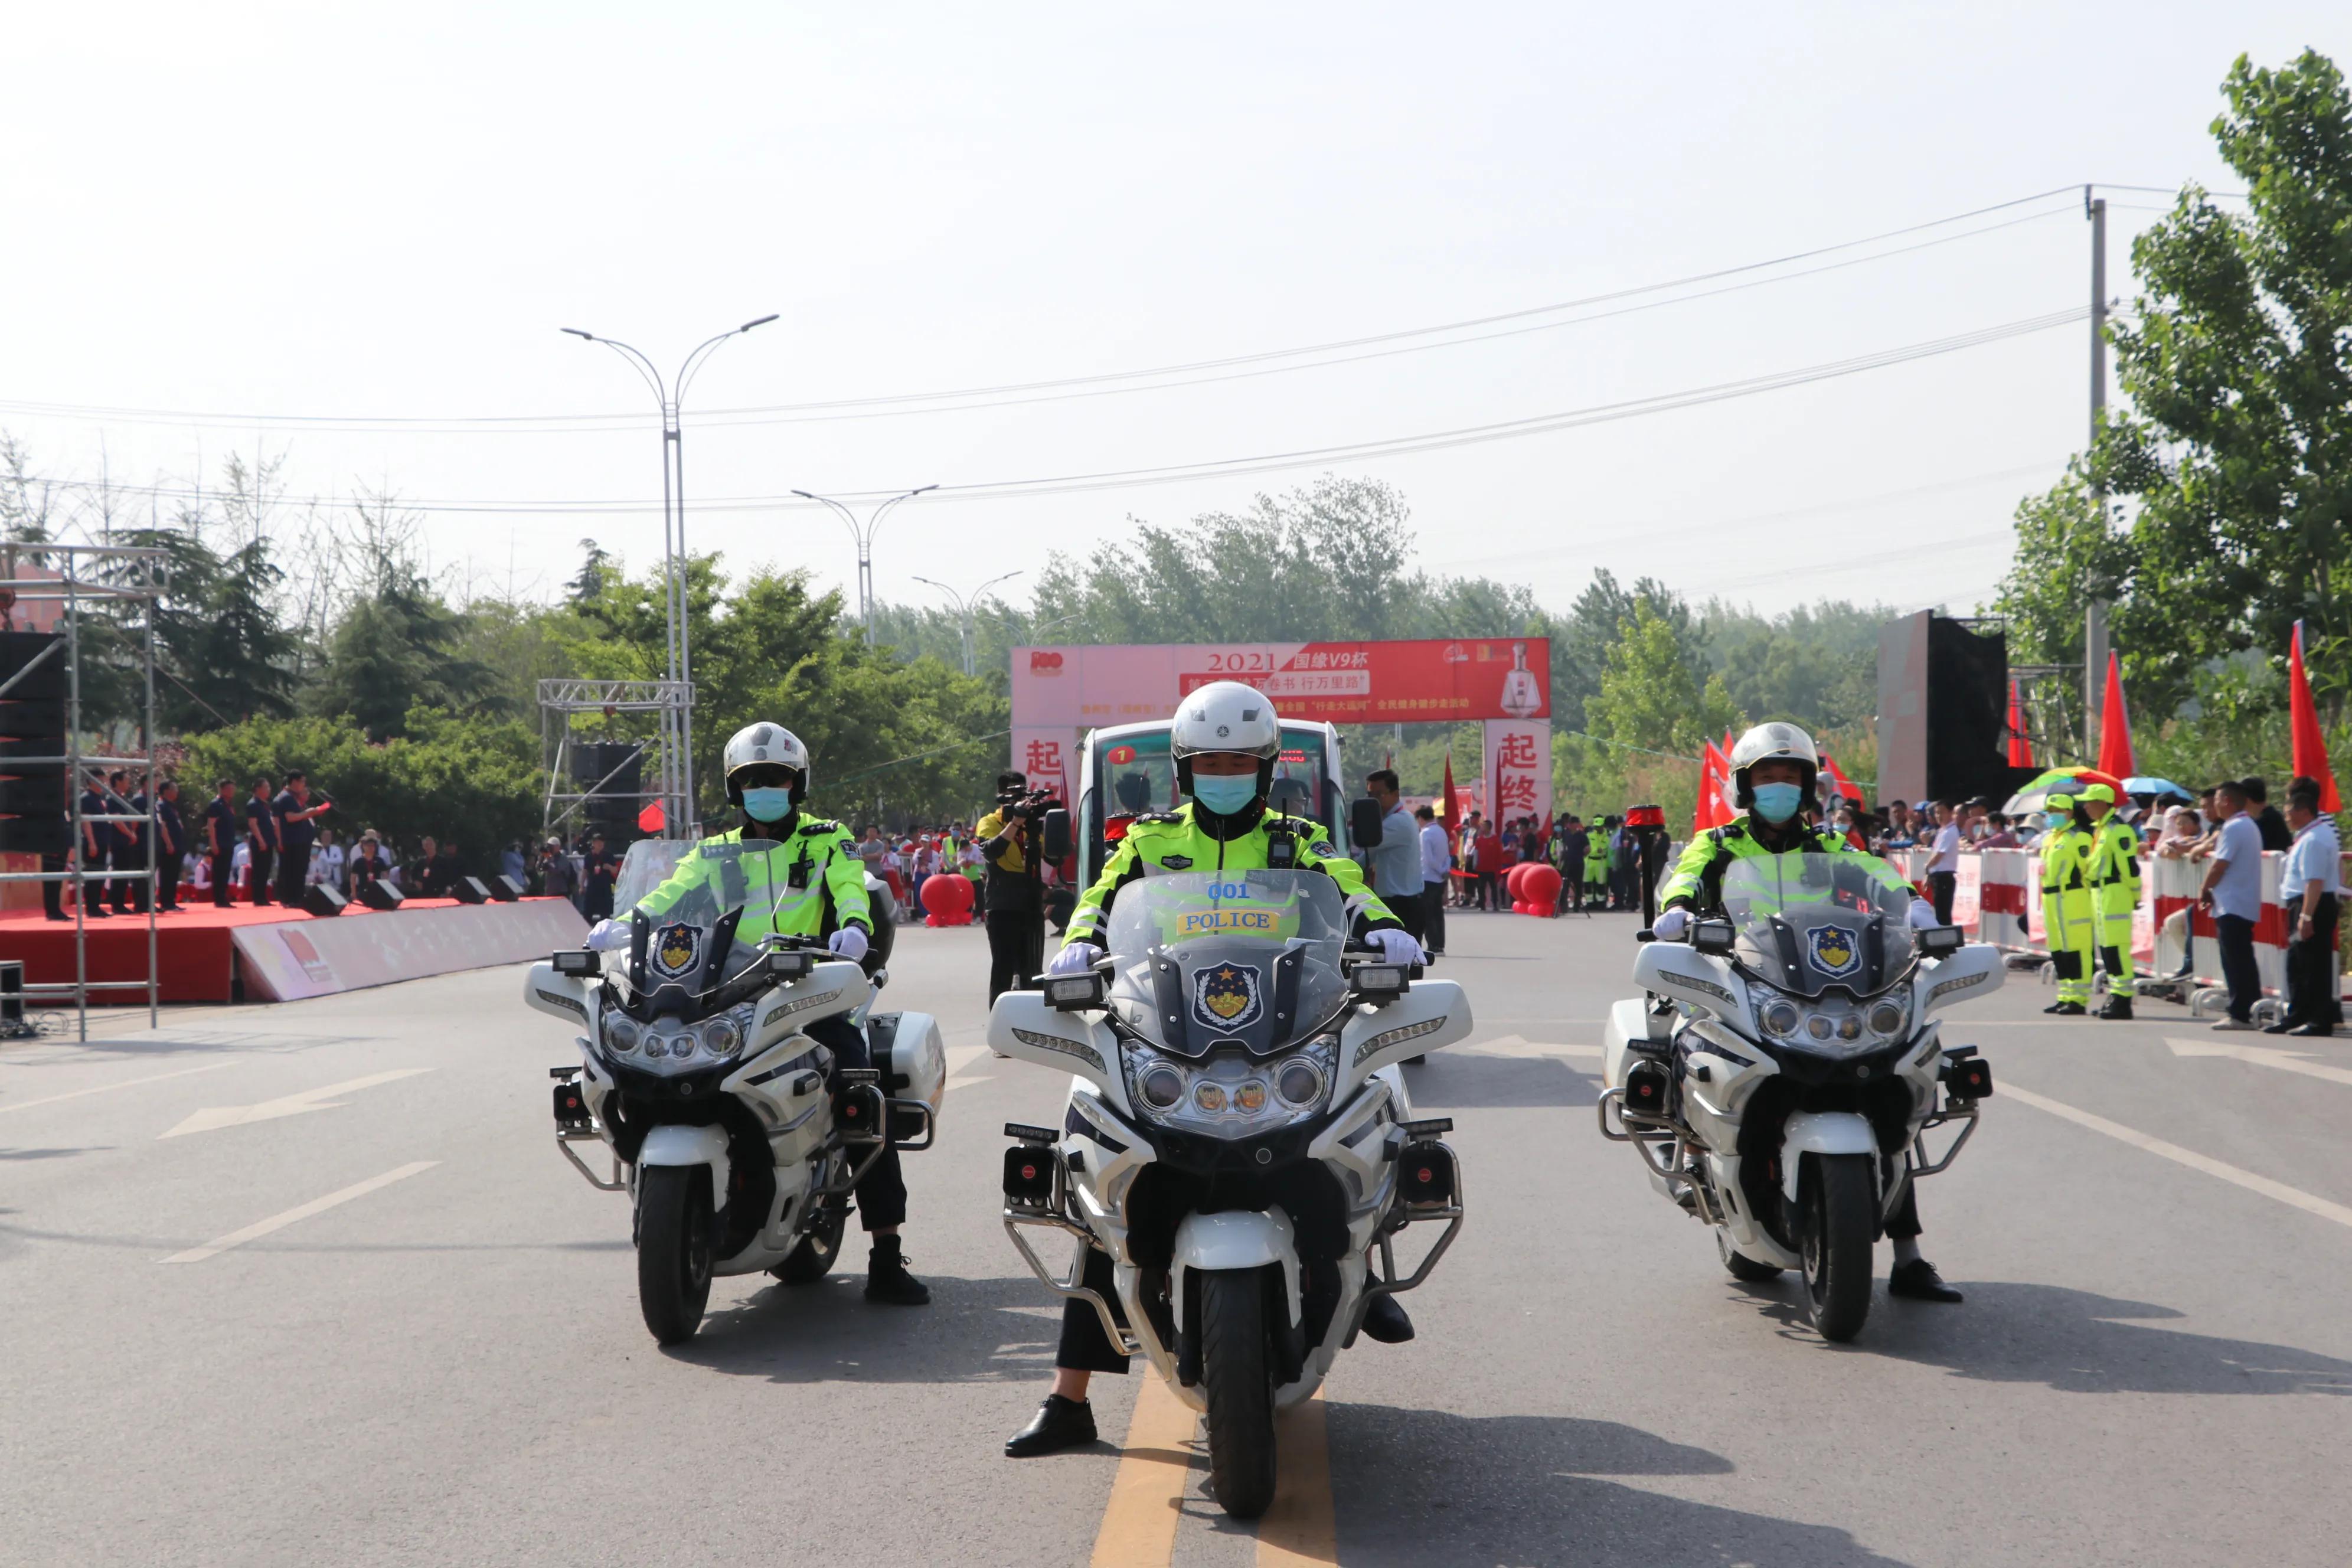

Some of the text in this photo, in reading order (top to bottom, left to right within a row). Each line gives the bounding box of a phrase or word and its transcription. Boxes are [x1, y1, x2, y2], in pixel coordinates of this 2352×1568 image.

[1208, 652, 1368, 671] 2021 国缘V9杯
[1118, 750, 1125, 761] 1
[1501, 733, 1537, 811] 起终
[1208, 884, 1250, 900] 001
[1186, 913, 1270, 930] POLICE
